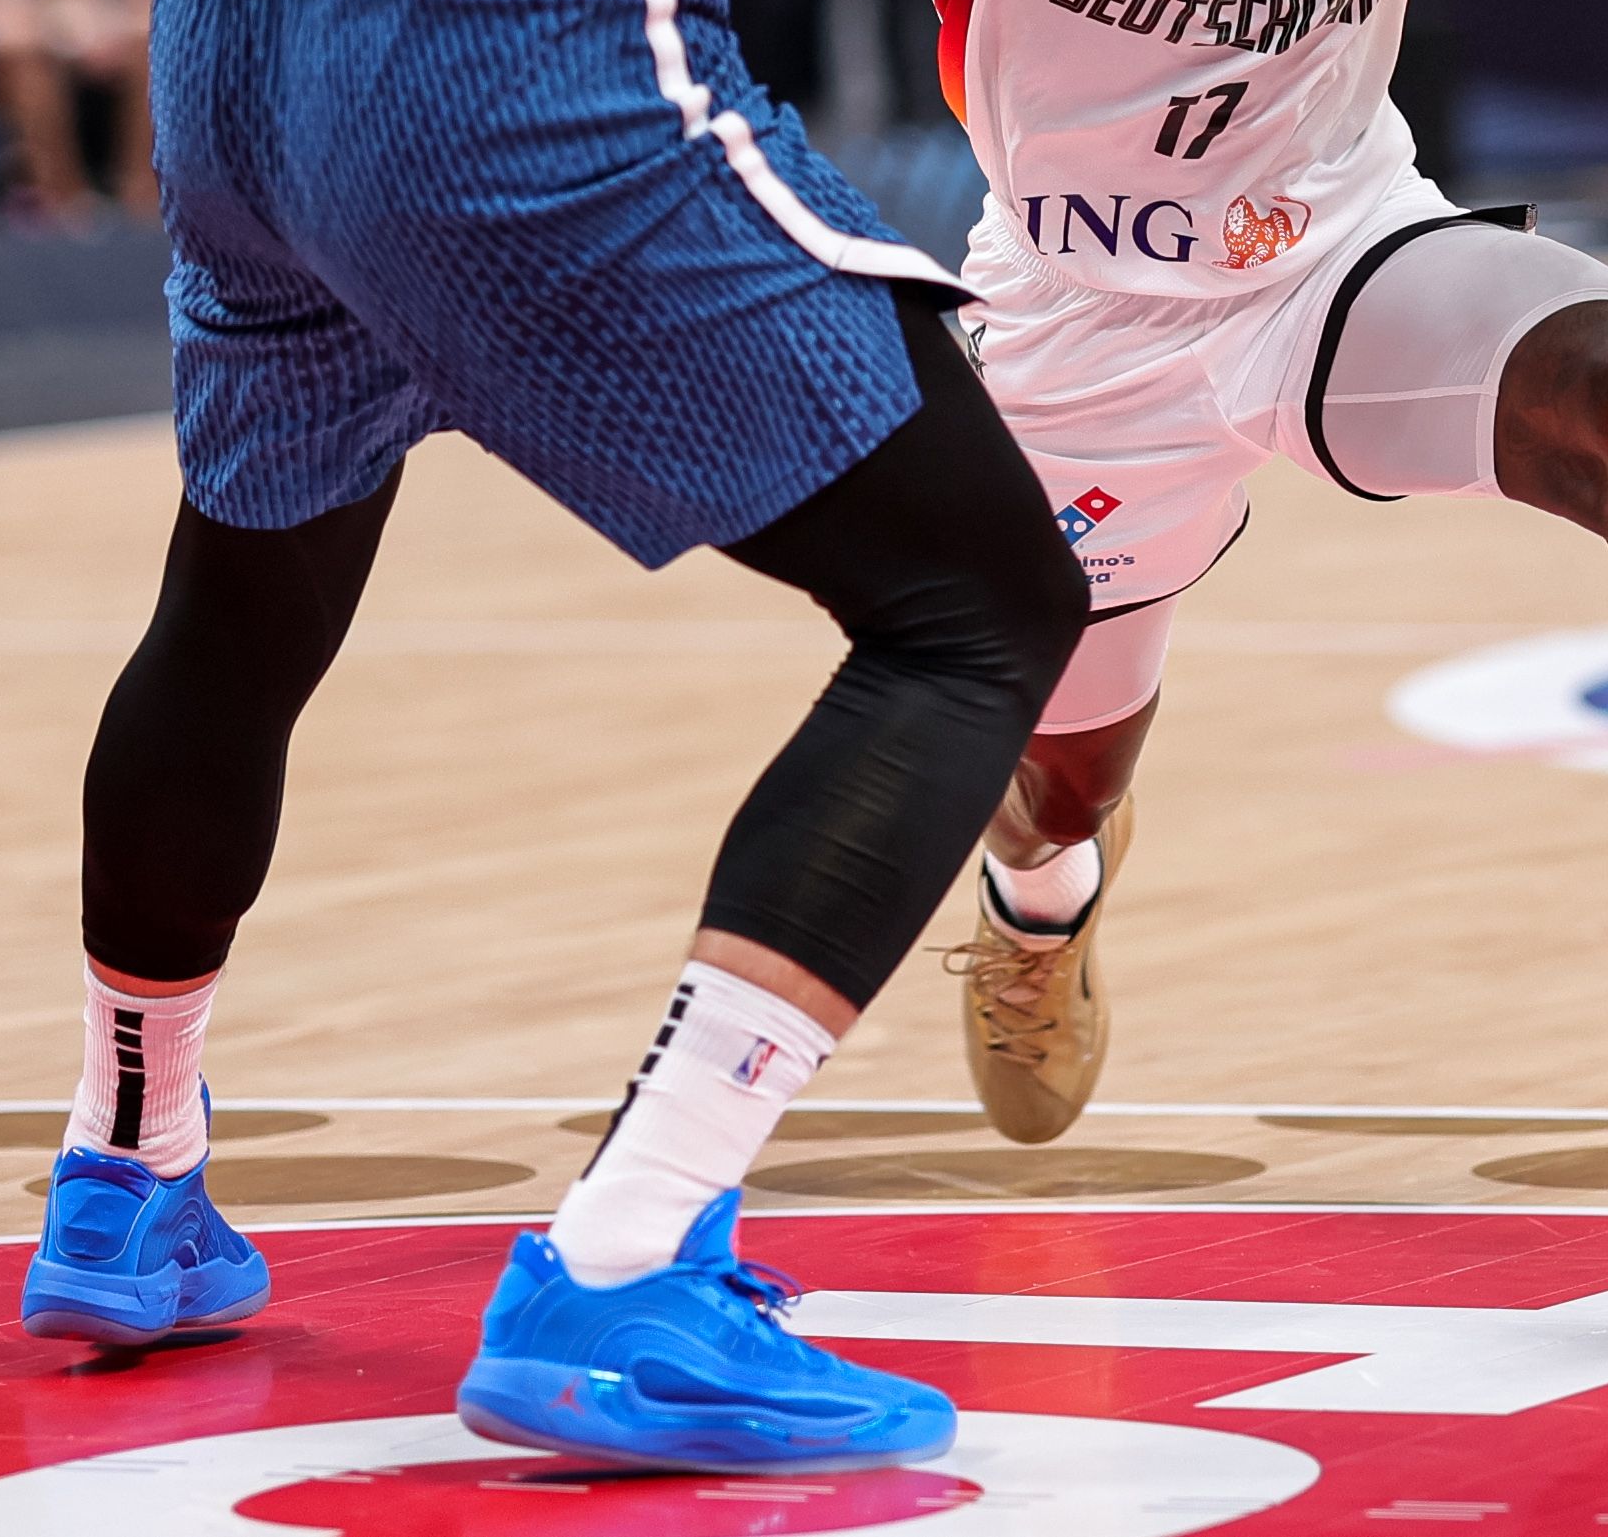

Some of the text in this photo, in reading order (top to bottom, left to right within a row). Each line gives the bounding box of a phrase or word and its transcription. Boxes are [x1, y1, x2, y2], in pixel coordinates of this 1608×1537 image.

[1154, 81, 1249, 159] 17
[1021, 194, 1199, 262] ING
[1082, 553, 1136, 568] ino's
